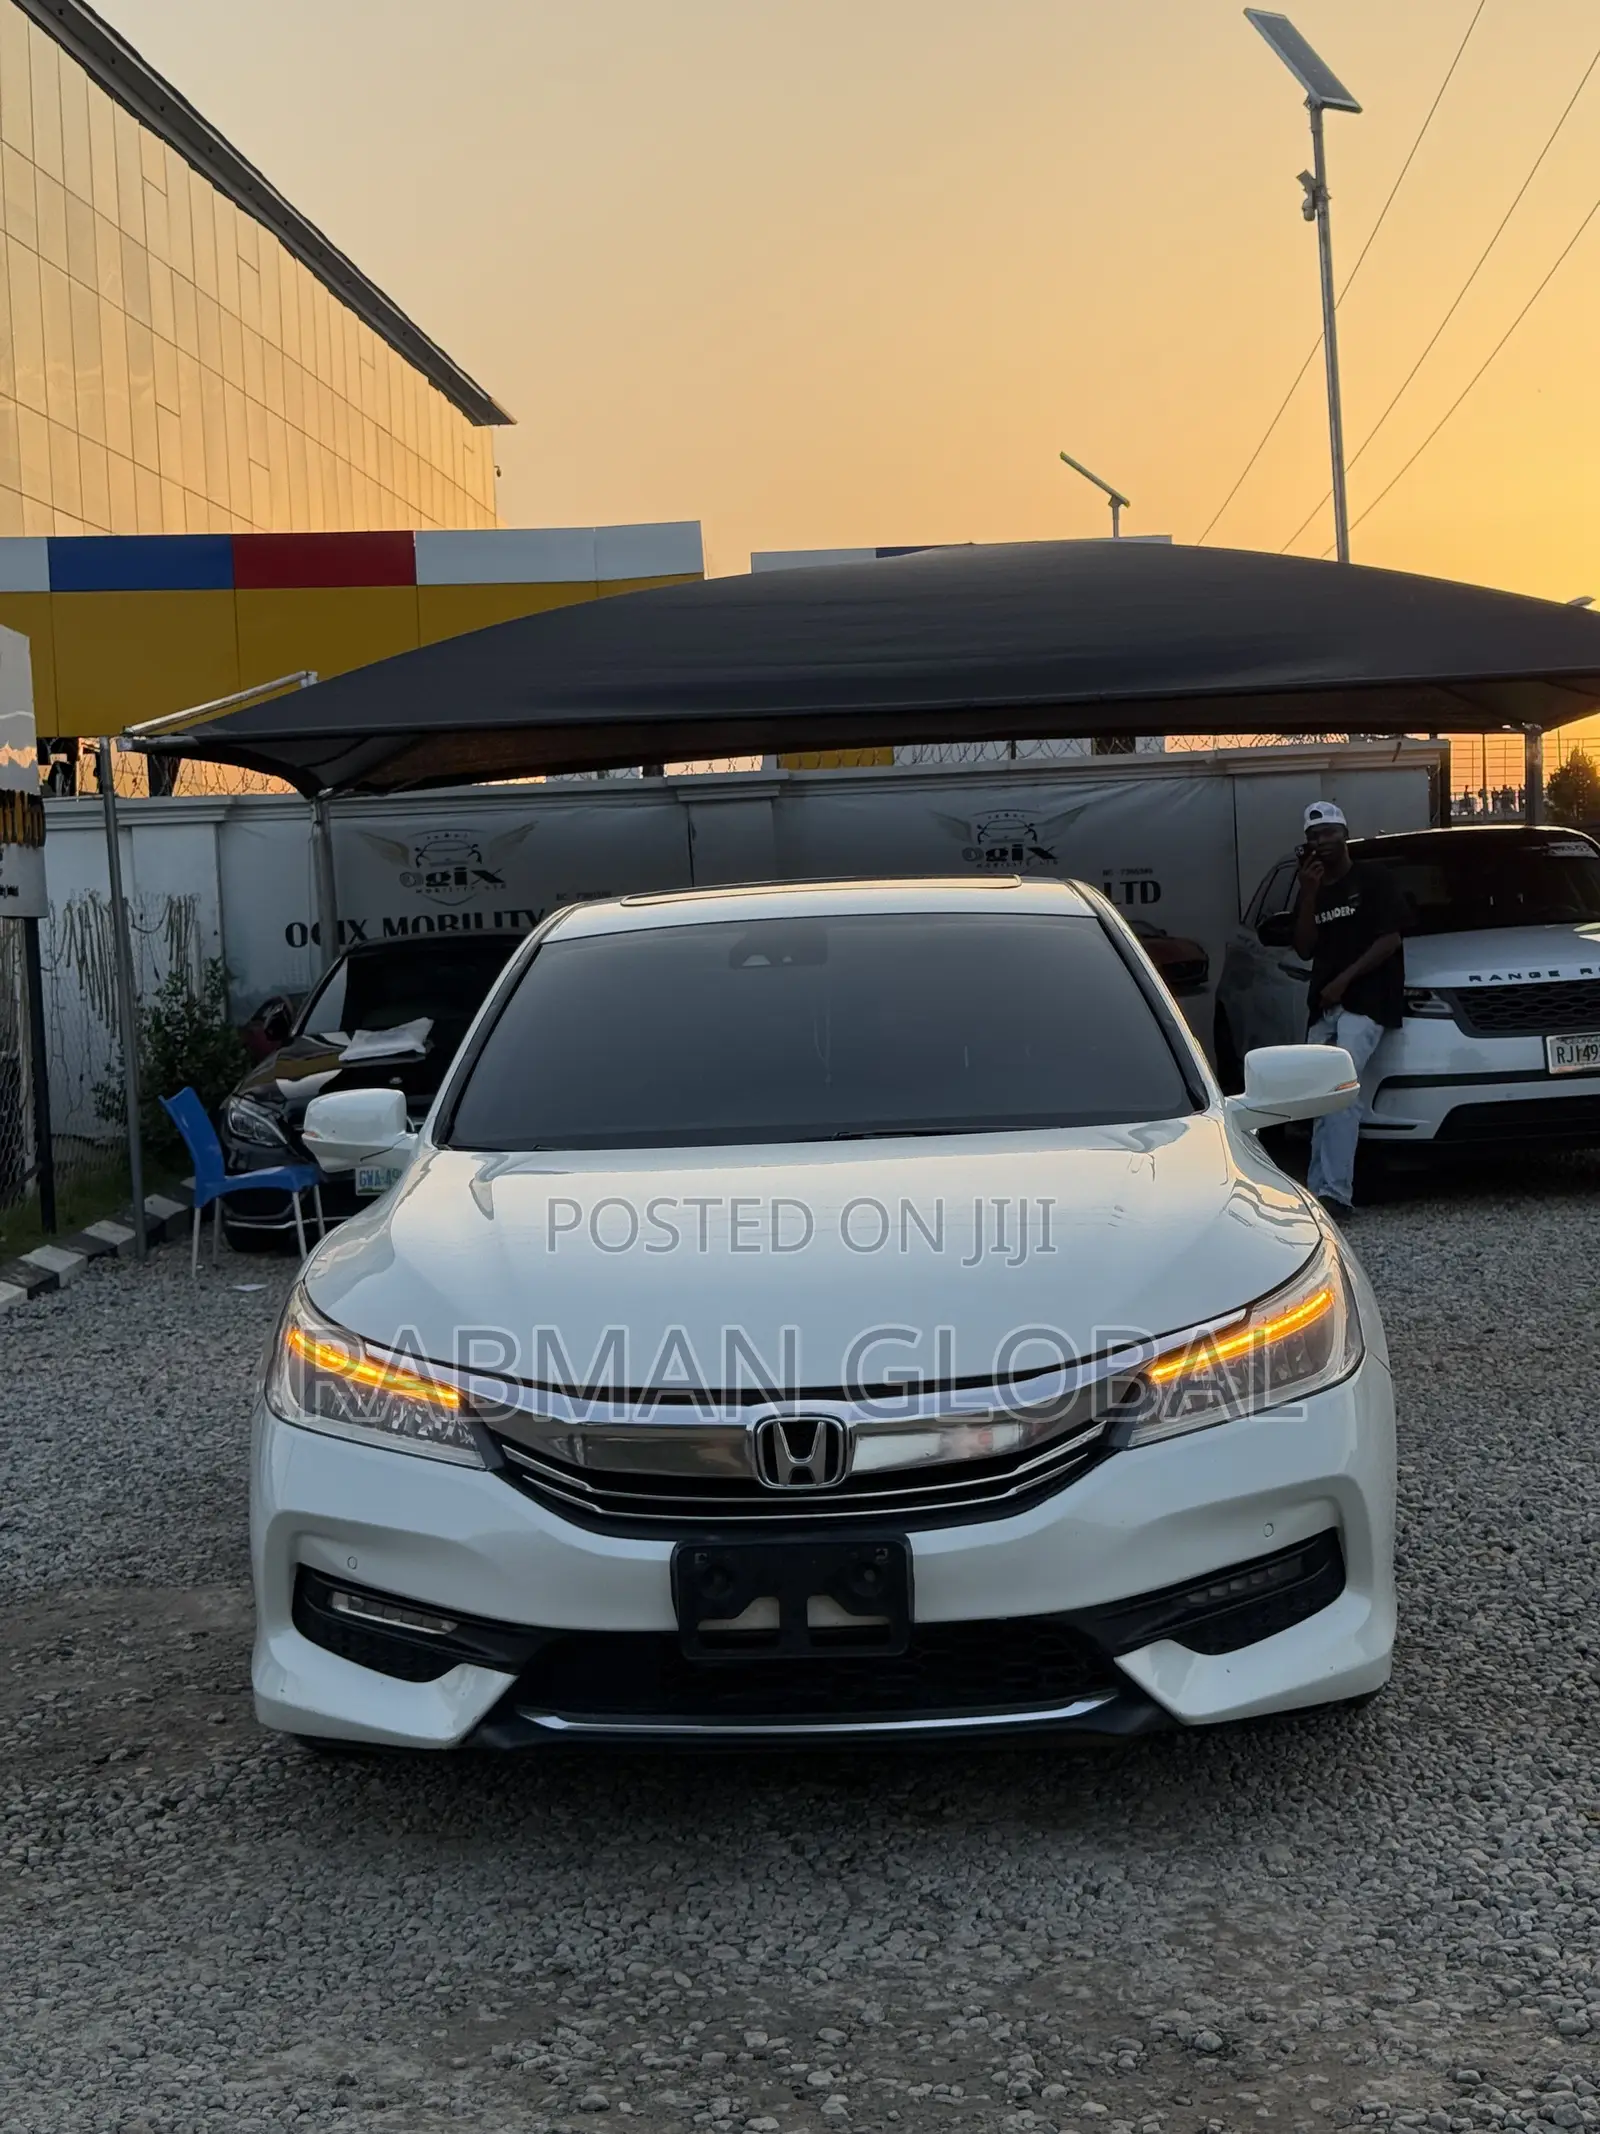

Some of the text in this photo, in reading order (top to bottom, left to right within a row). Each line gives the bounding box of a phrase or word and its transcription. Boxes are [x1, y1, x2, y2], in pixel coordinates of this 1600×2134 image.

[1103, 880, 1161, 905] LTD
[1469, 967, 1600, 982] RANGE R
